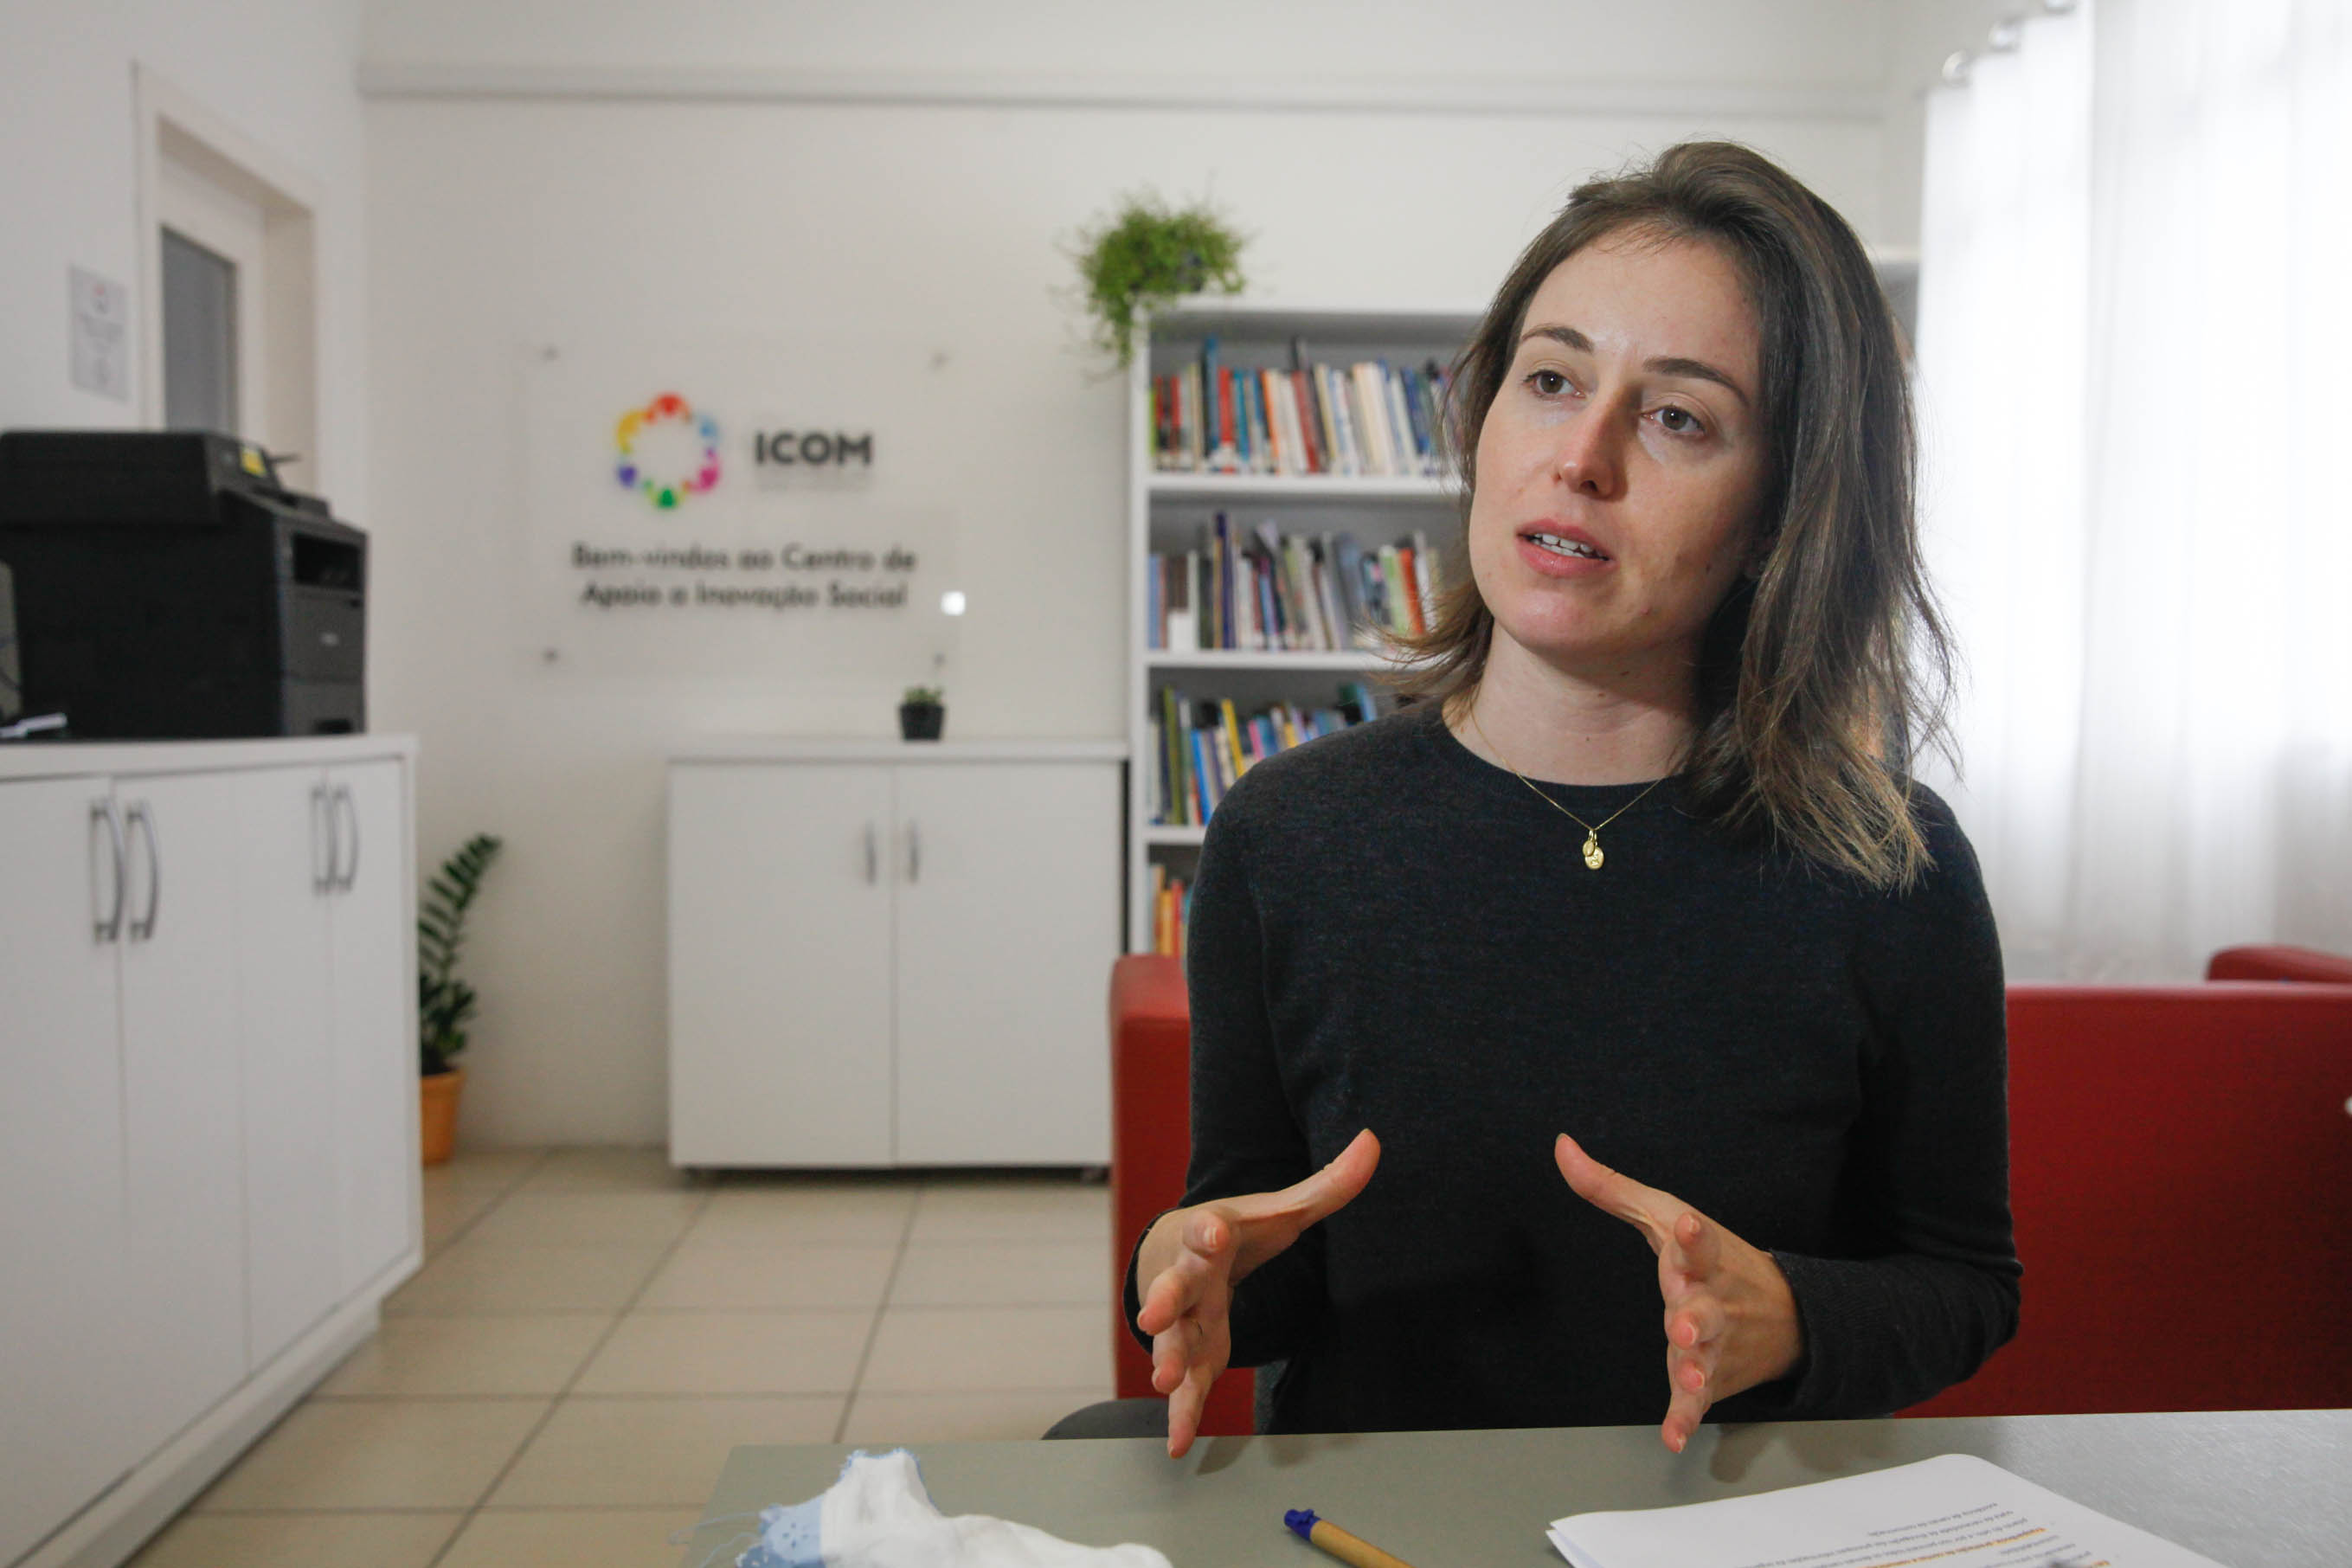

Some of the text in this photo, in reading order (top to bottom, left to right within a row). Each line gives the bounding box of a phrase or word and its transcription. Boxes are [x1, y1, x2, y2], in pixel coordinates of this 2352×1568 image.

[755, 432, 871, 465] ICOM
[739, 550, 774, 570] ao
[781, 543, 873, 570] Centro
[883, 545, 916, 571] de
[582, 581, 907, 611] Apoio e Inovação Social
